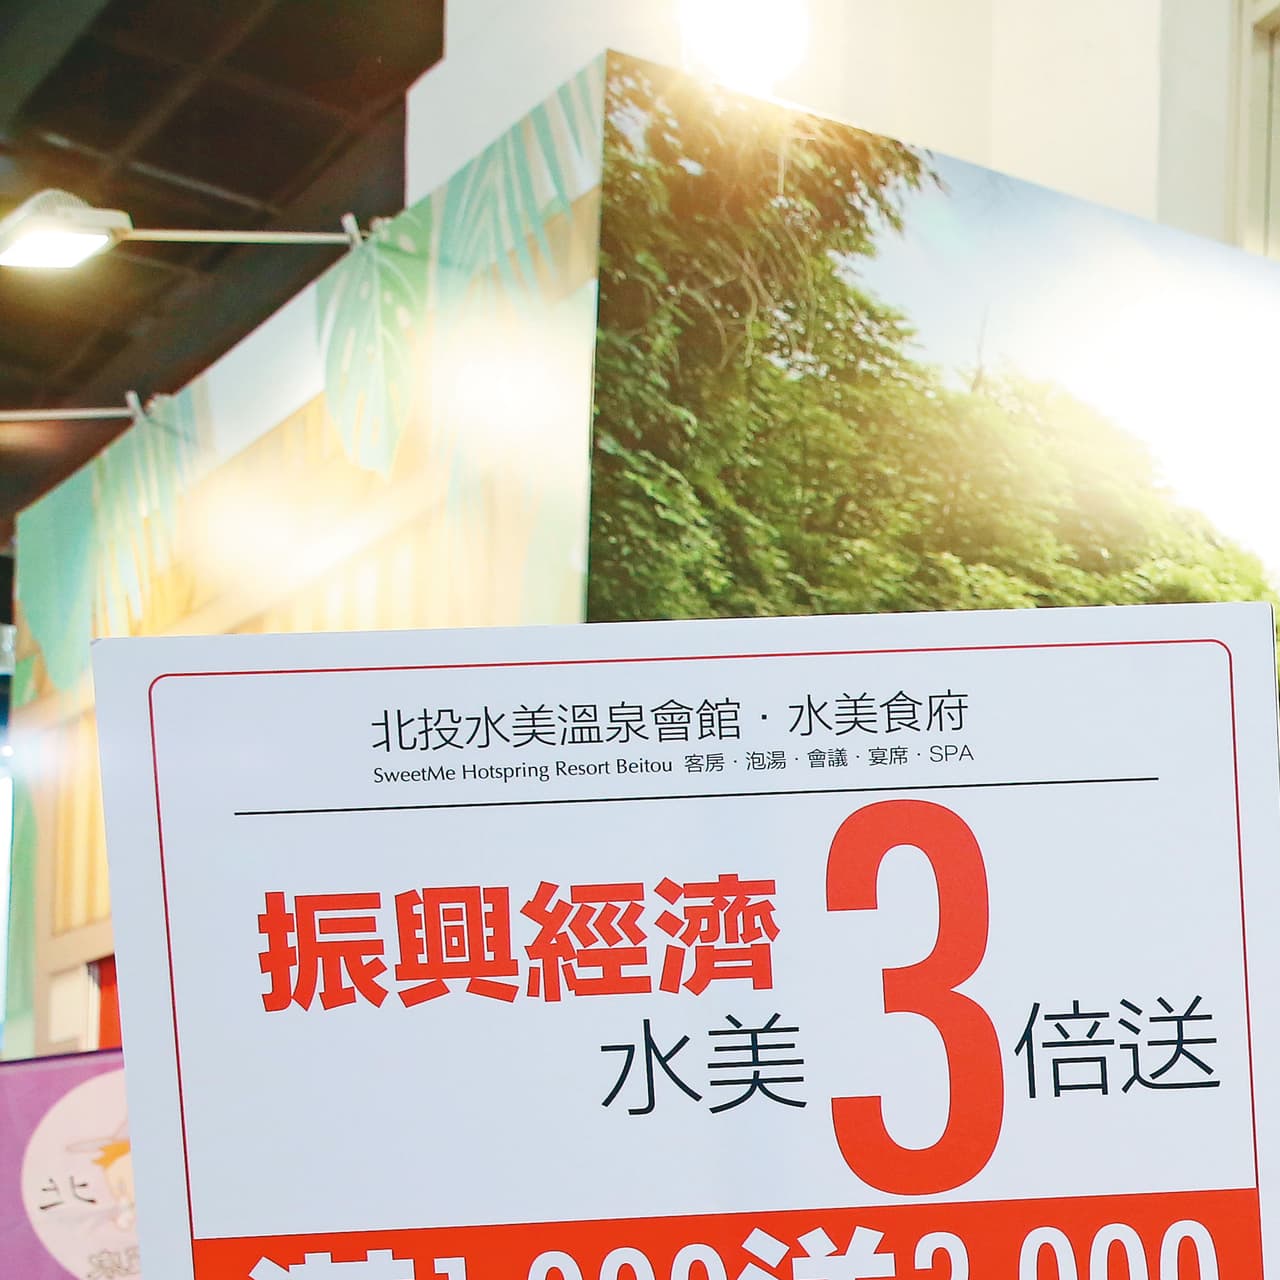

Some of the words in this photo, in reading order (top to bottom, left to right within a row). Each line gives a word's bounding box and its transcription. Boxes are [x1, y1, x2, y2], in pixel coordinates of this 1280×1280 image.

[374, 766, 455, 783] SweetMe
[463, 761, 549, 783] Hotspring
[556, 759, 609, 776] Resort
[617, 757, 672, 773] Beitou
[258, 873, 780, 1012] 振興經濟
